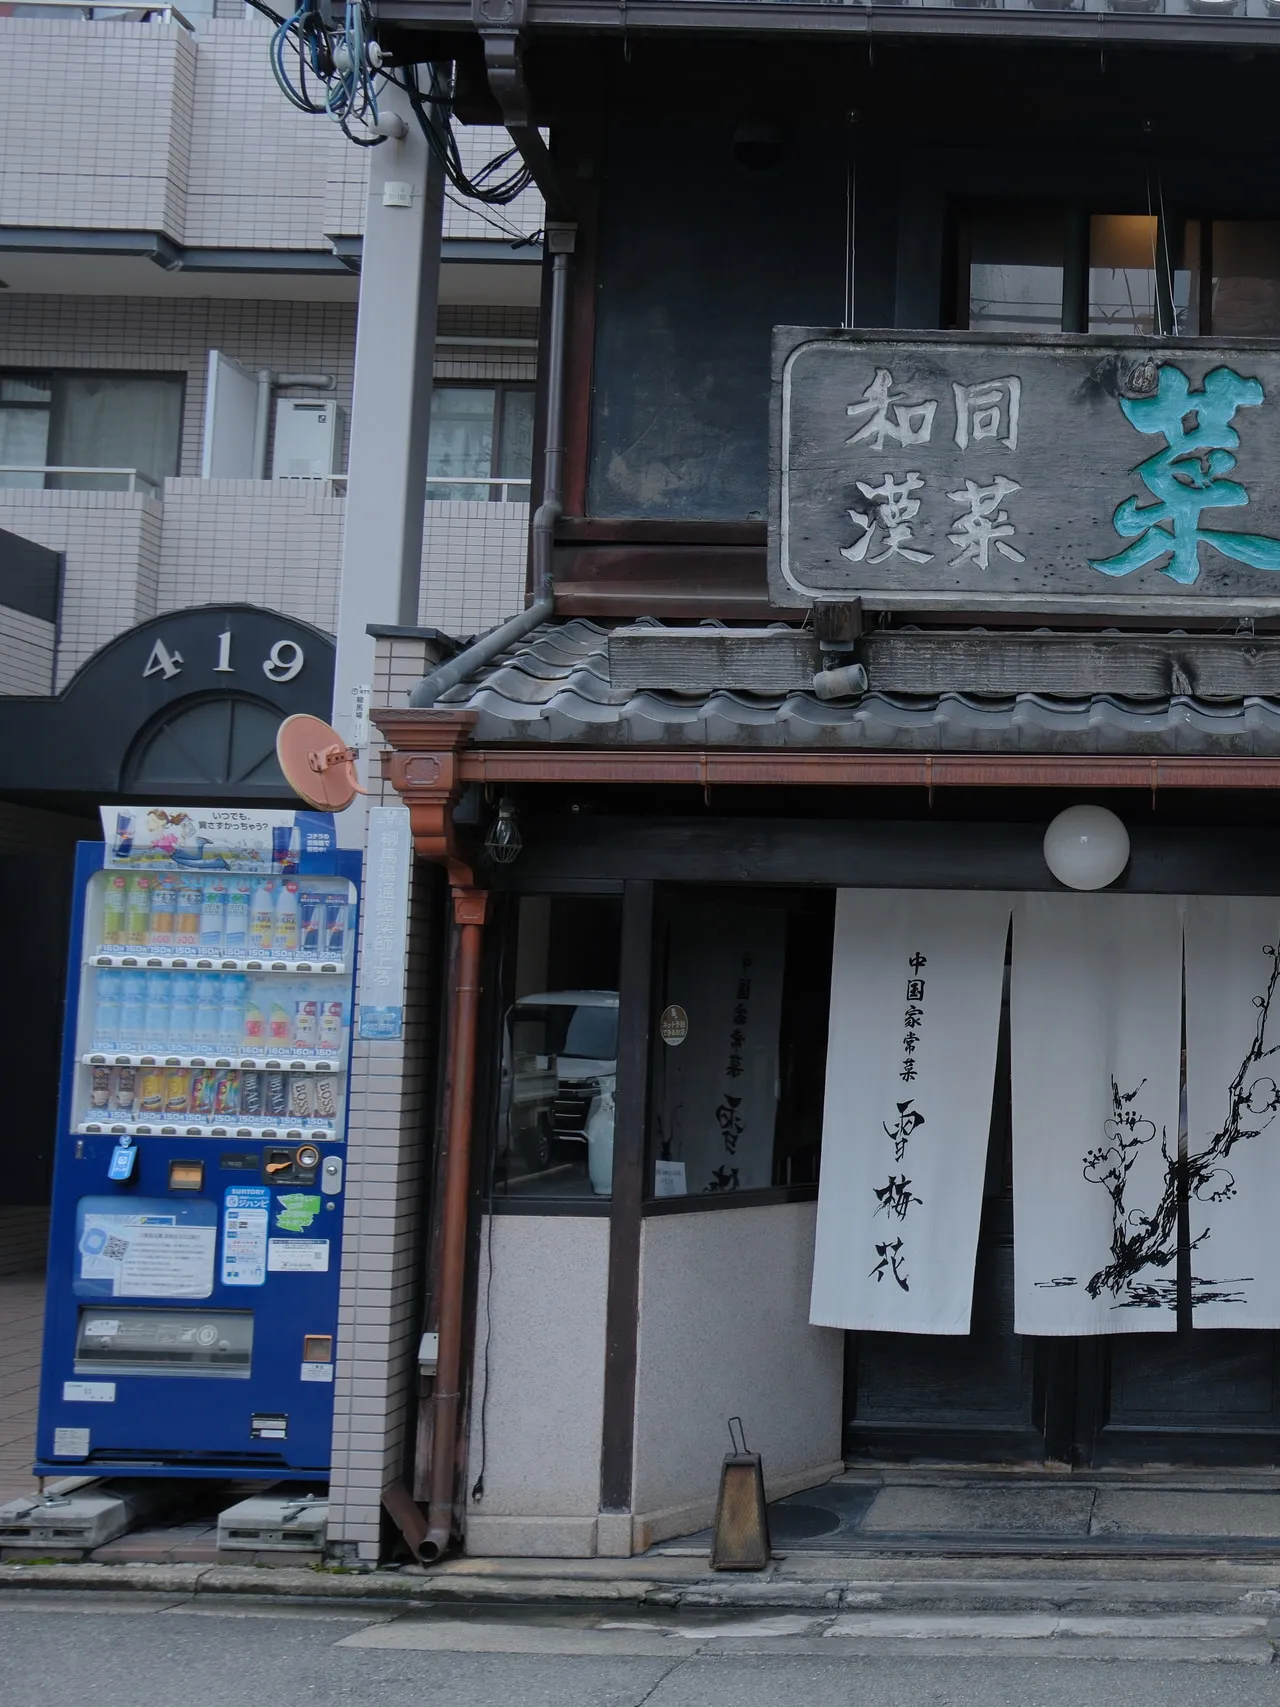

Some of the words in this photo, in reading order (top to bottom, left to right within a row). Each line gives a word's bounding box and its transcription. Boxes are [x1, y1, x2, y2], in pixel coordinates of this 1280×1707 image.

[142, 630, 305, 682] 419
[899, 951, 927, 1083] 中国家常菜
[296, 1083, 309, 1115] BOSS
[320, 1082, 334, 1114] BOSS
[868, 1098, 926, 1292] 雪梅花
